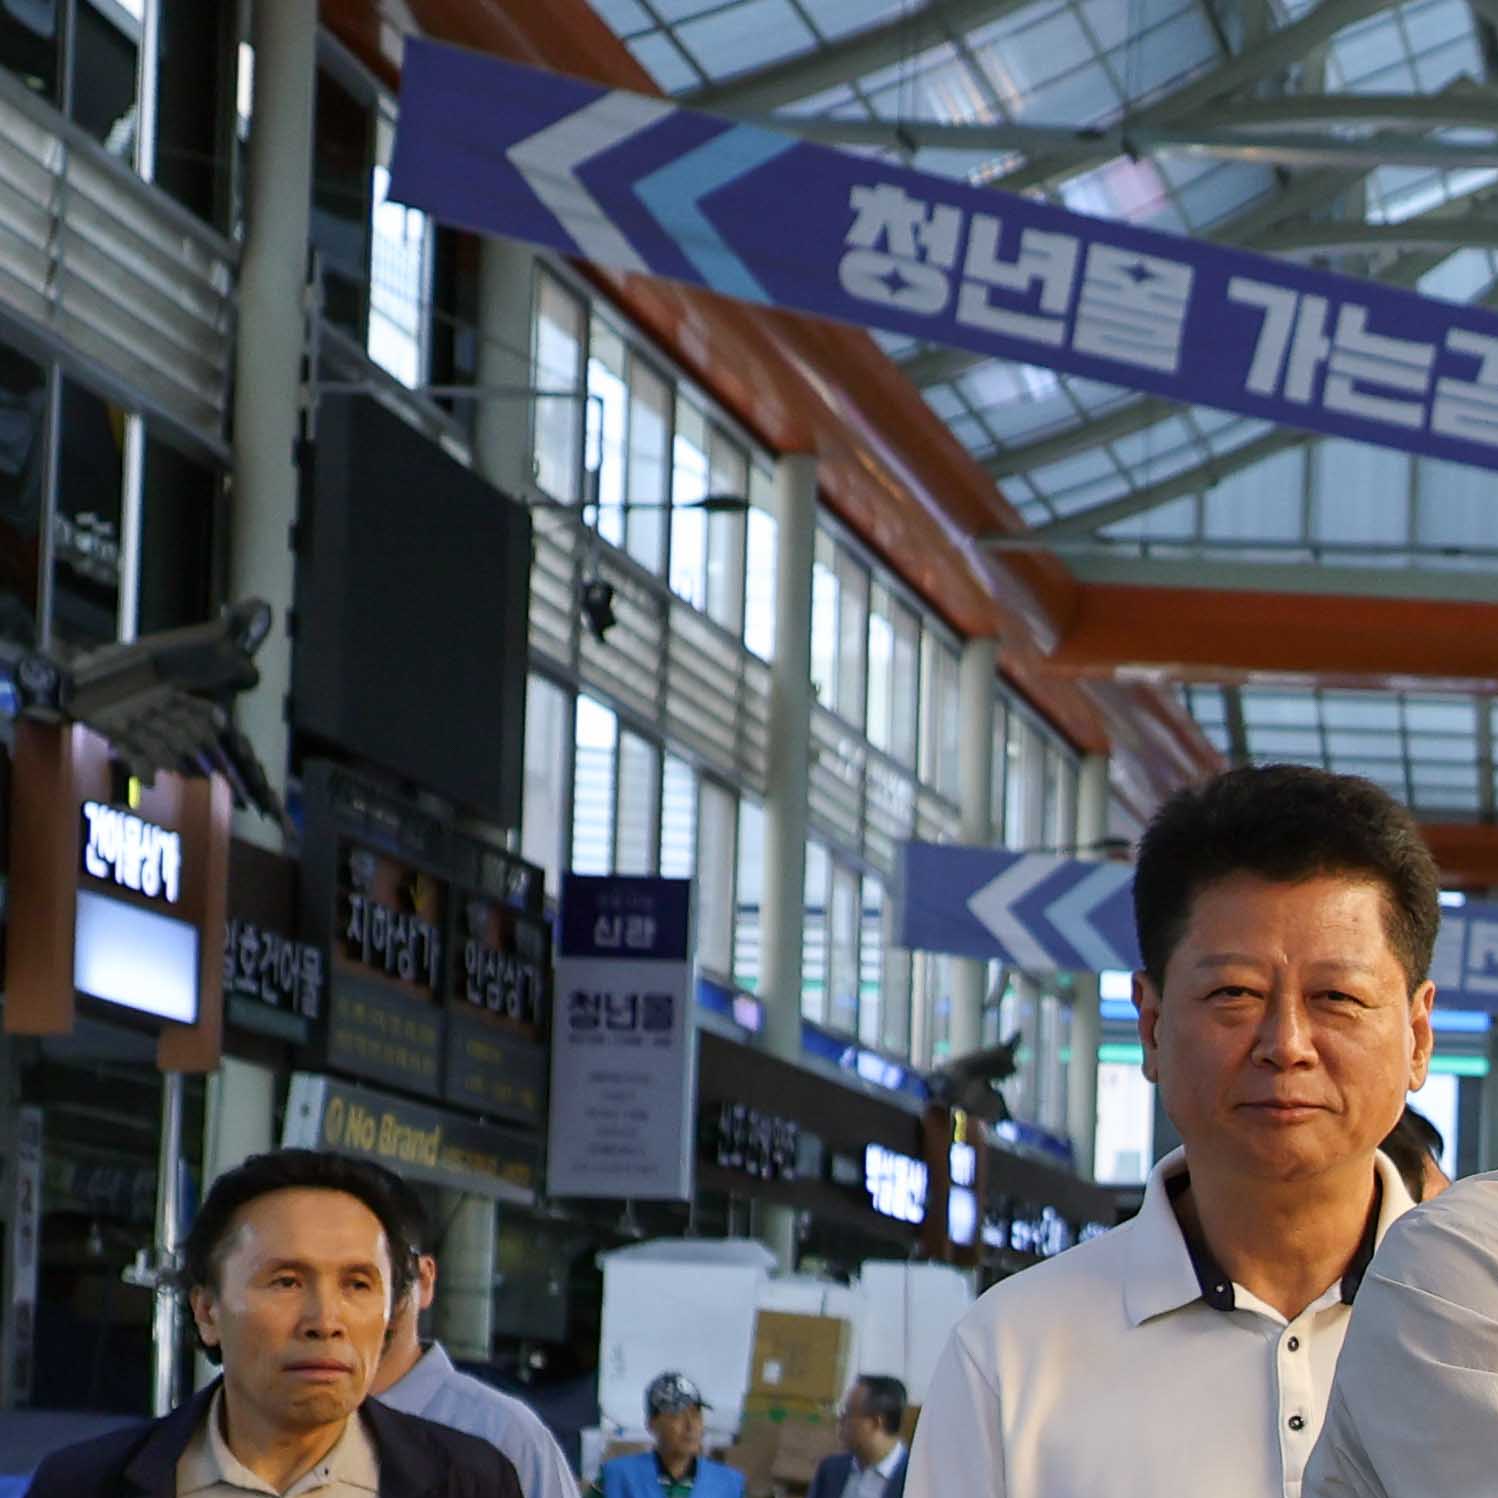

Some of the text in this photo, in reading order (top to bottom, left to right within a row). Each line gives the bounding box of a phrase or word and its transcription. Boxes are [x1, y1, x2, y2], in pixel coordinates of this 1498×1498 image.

[838, 184, 1195, 374] 청년몰
[568, 990, 674, 1032] 청년몰
[344, 1106, 377, 1154] No
[378, 1114, 443, 1170] Brand
